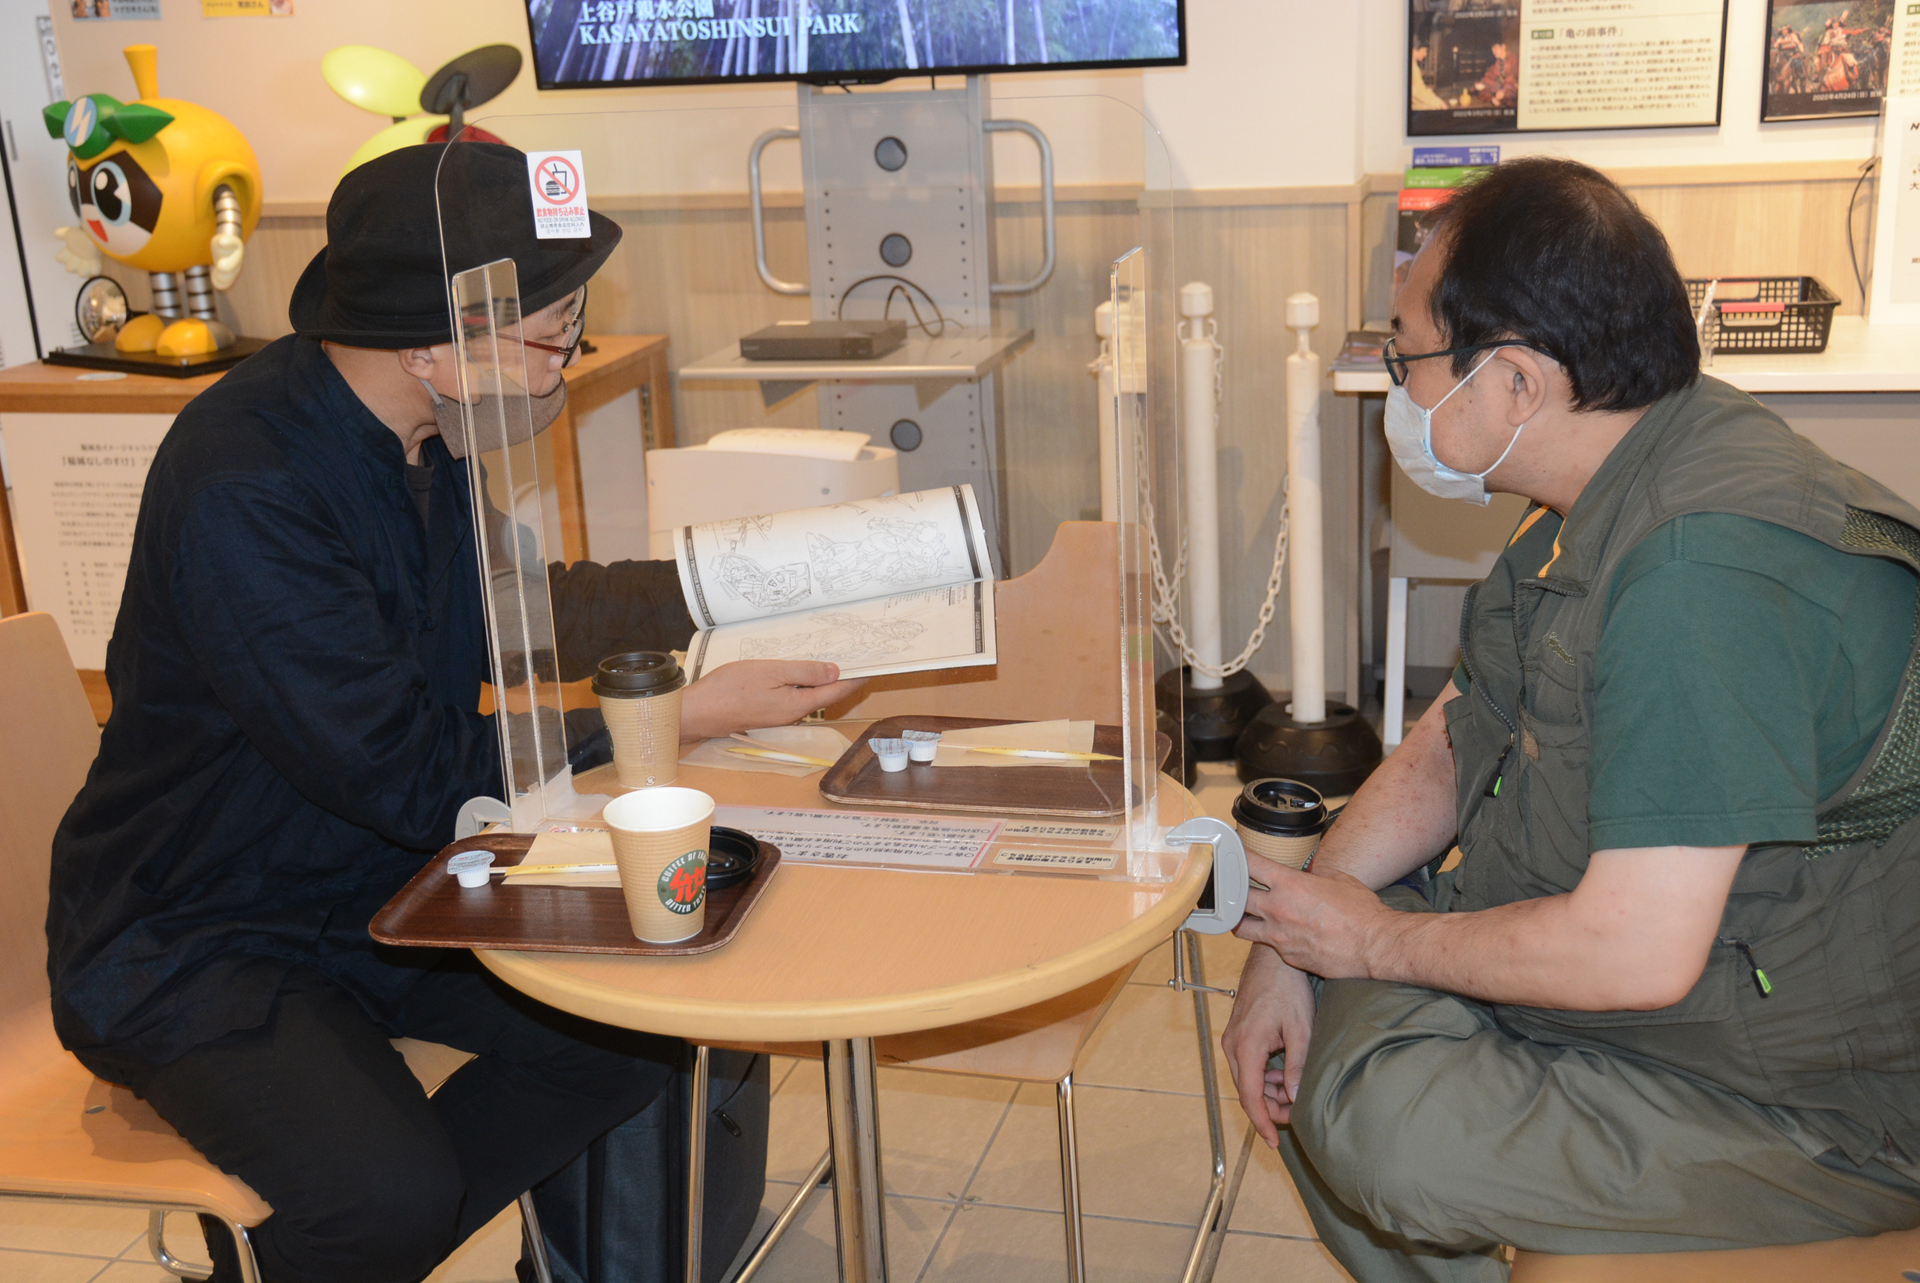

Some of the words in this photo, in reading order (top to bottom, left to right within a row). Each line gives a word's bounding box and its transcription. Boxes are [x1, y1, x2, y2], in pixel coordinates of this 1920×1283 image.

[579, 0, 714, 24] 上谷戸親水公園
[579, 17, 790, 45] KASAYATOSHINSUI
[798, 13, 861, 36] PARK
[537, 206, 585, 217] 飲食物持ち込み禁止
[784, 850, 850, 860] お客さまへ
[662, 858, 686, 882] COFFEE
[688, 852, 697, 861] OF
[665, 897, 692, 913] BITTER
